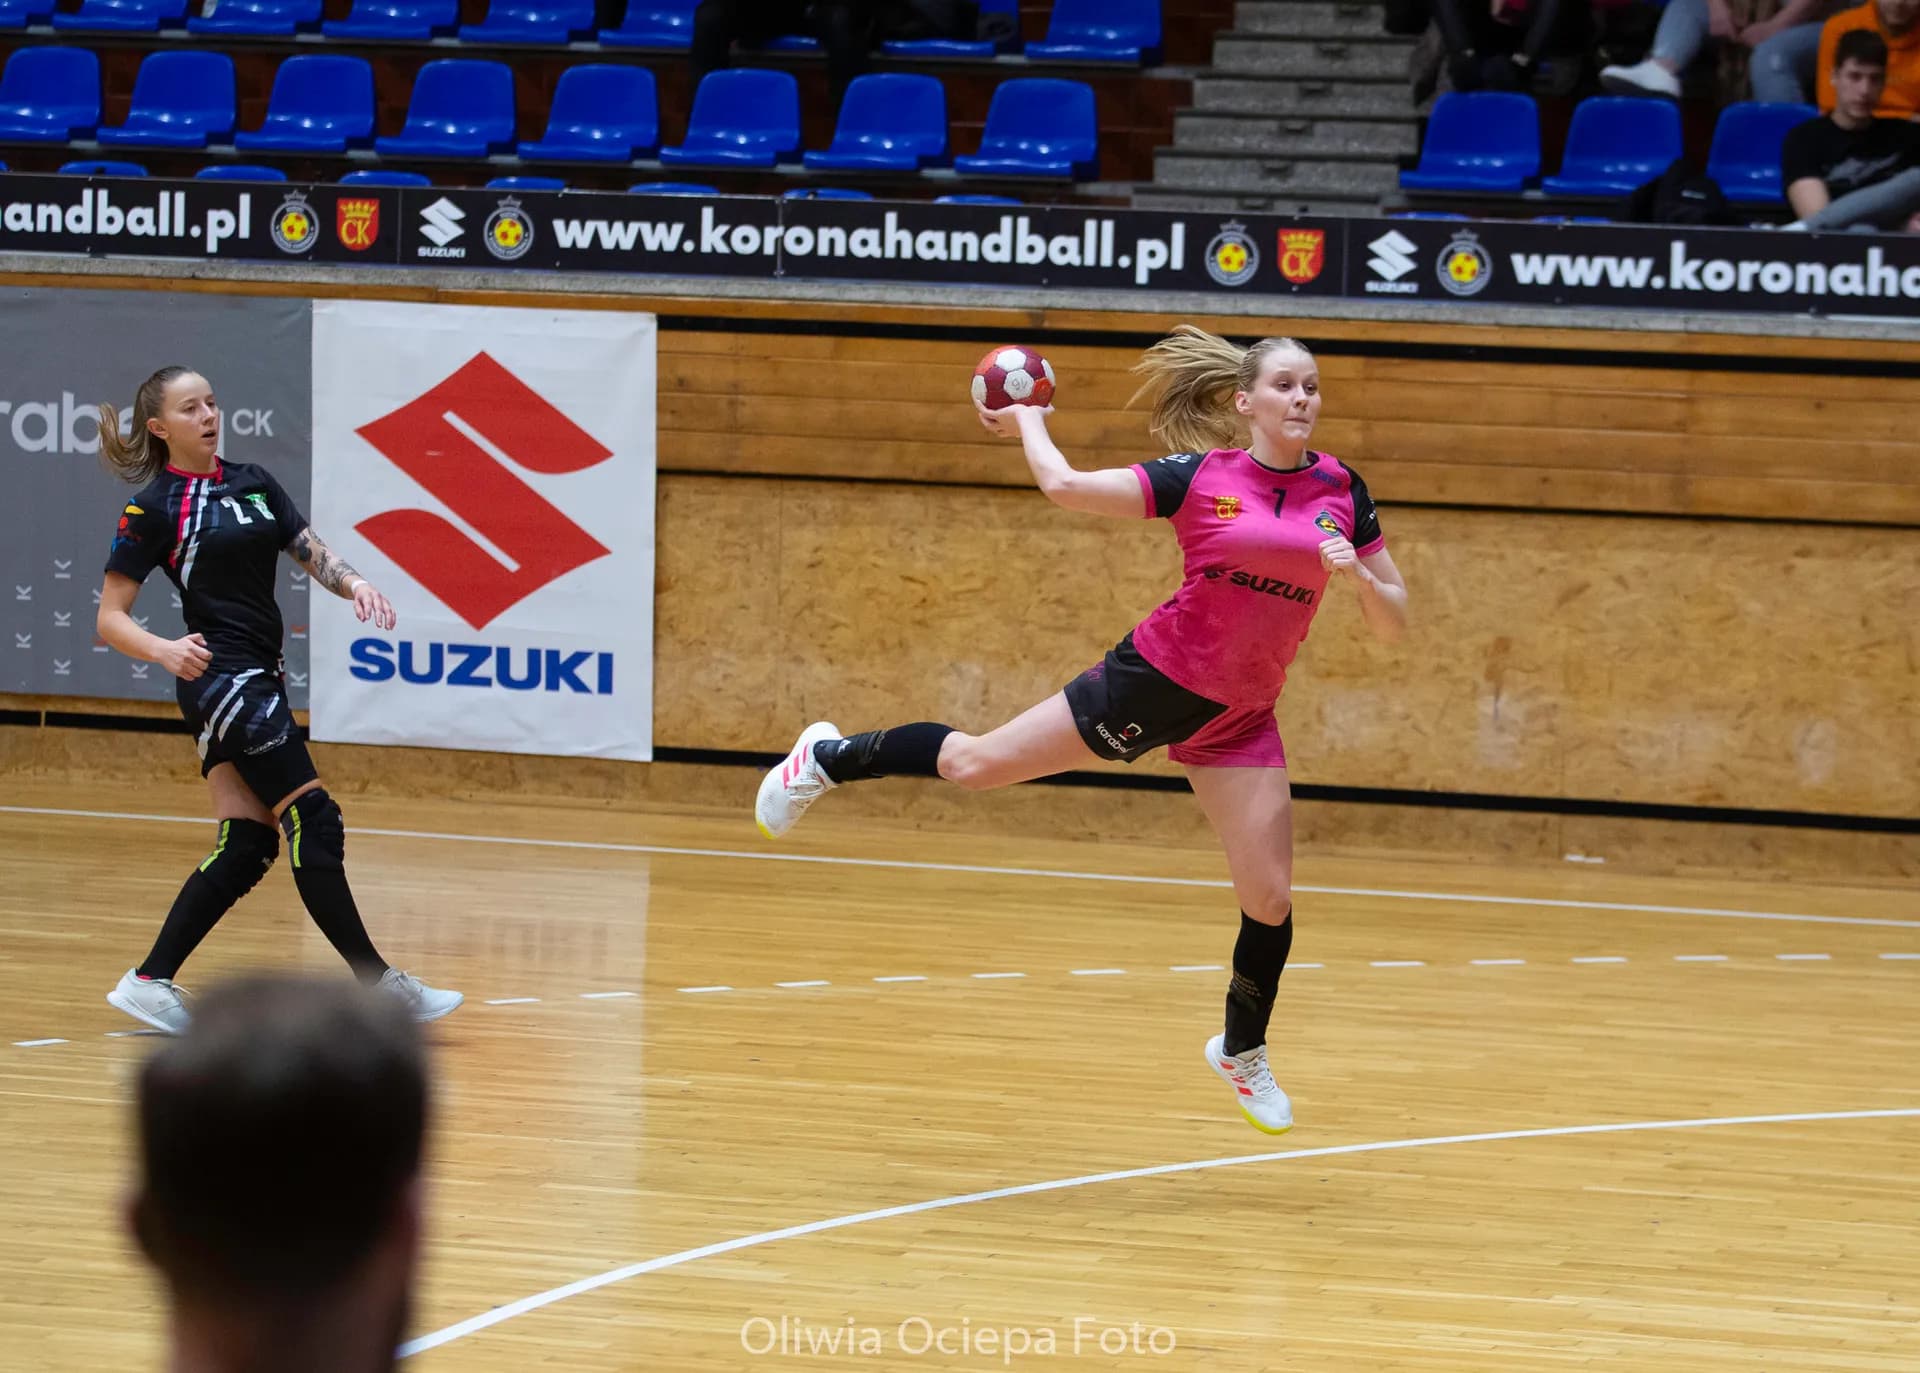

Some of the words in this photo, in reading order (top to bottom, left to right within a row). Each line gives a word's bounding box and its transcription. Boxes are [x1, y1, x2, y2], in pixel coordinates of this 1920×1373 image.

[0, 188, 250, 254] andball.pl
[417, 246, 466, 258] SUZUKI
[552, 206, 1186, 285] www.koronahandball.pl
[1364, 280, 1419, 293] SUZUKI
[231, 408, 274, 438] CK
[1229, 570, 1316, 606] SUZUKI
[348, 637, 613, 695] SUZUKI
